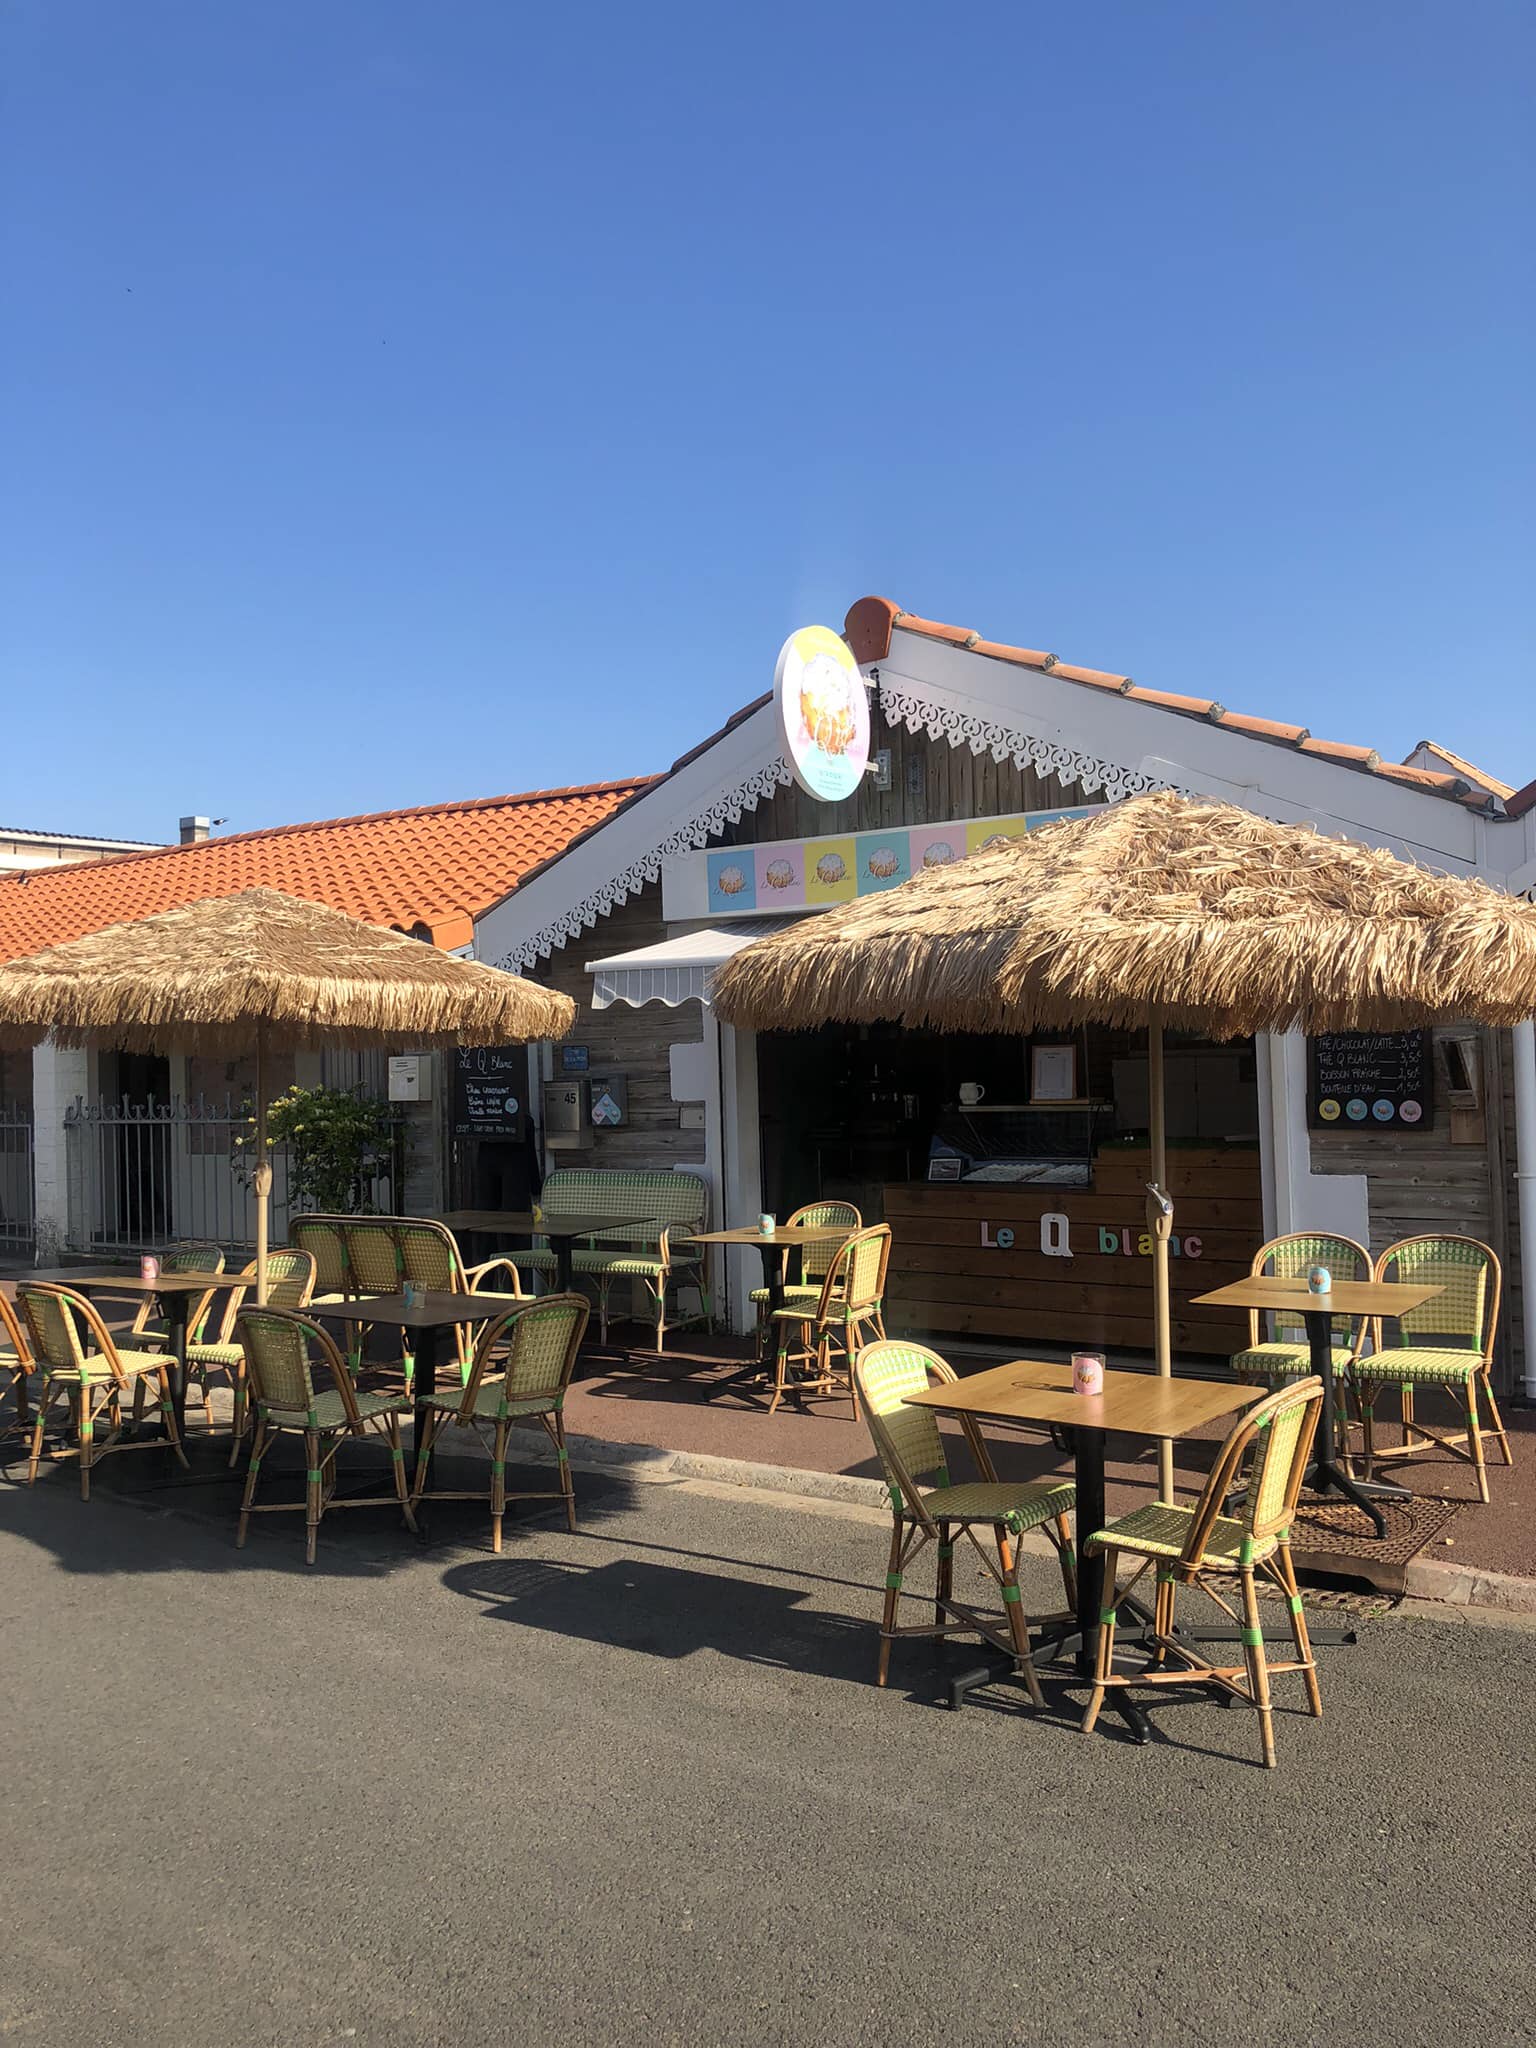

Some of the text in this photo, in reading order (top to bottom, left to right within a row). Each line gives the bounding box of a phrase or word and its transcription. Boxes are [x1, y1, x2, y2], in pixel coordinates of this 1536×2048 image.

[458, 1047, 472, 1068] Le
[477, 1048, 488, 1075] Q
[1336, 1052, 1345, 1067] Q
[1346, 1053, 1376, 1065] BLANC
[564, 1093, 577, 1104] 45
[980, 1212, 1203, 1258] Le Q blanc
